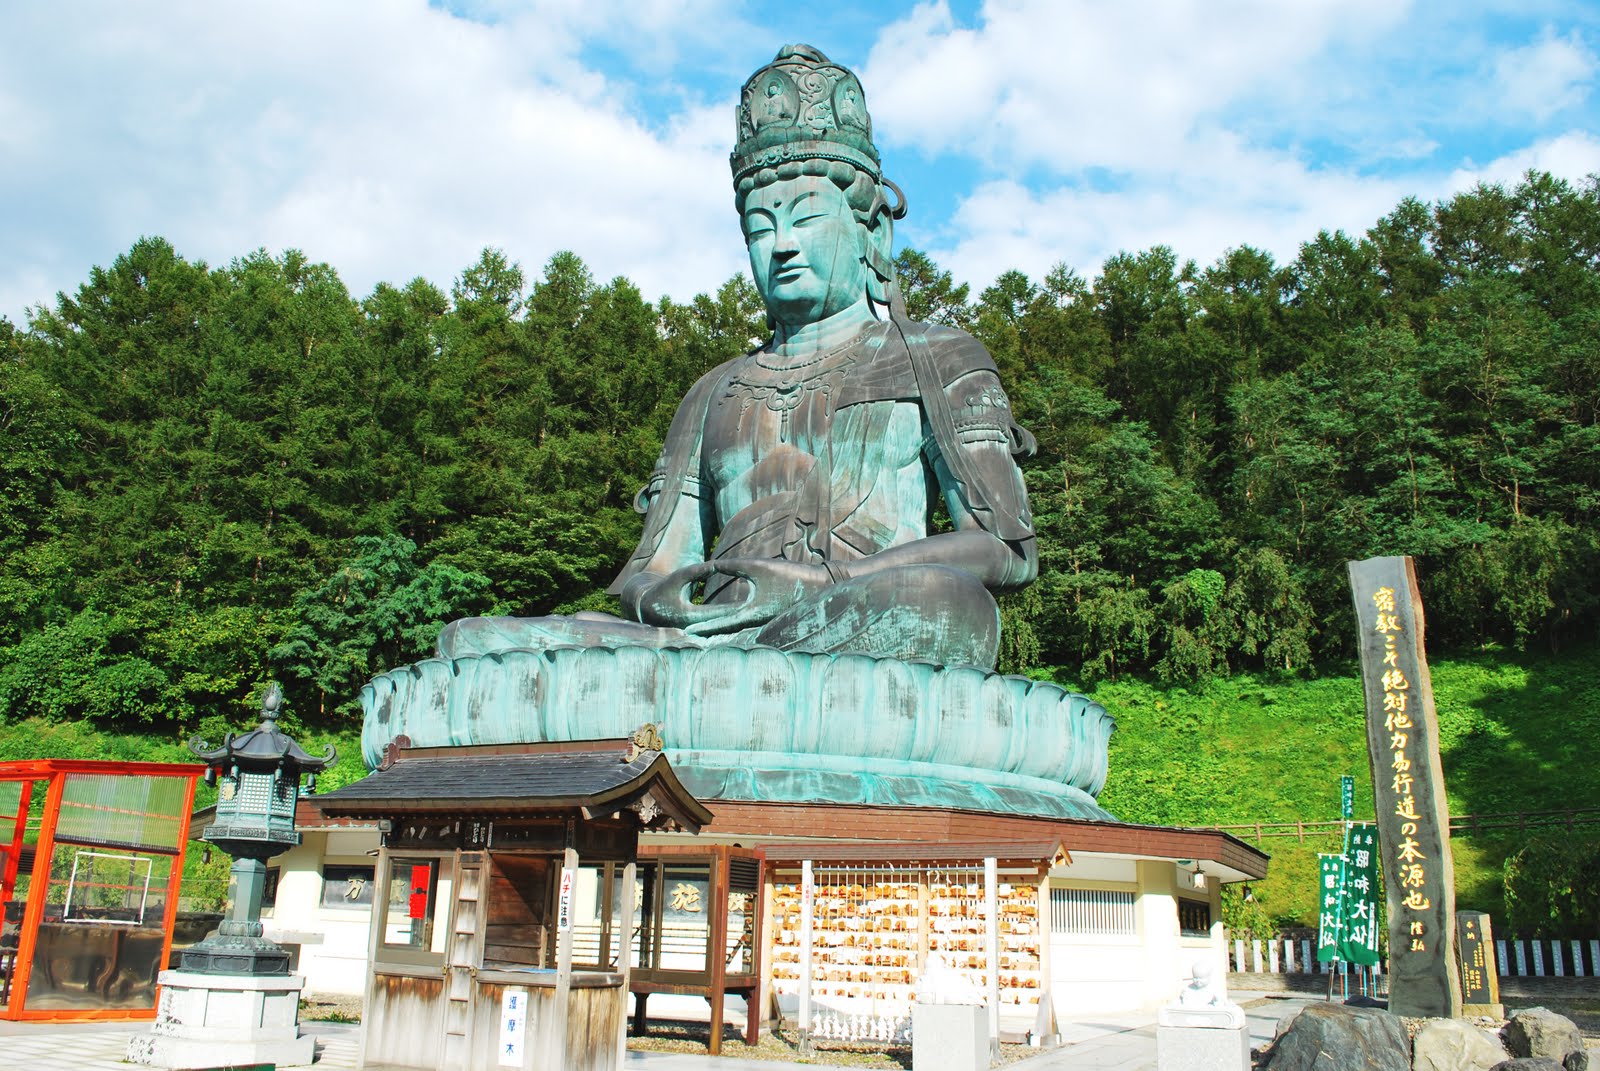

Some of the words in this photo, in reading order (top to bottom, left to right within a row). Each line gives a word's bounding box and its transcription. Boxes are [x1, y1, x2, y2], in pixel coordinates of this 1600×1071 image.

[561, 874, 571, 927] ハチに注意
